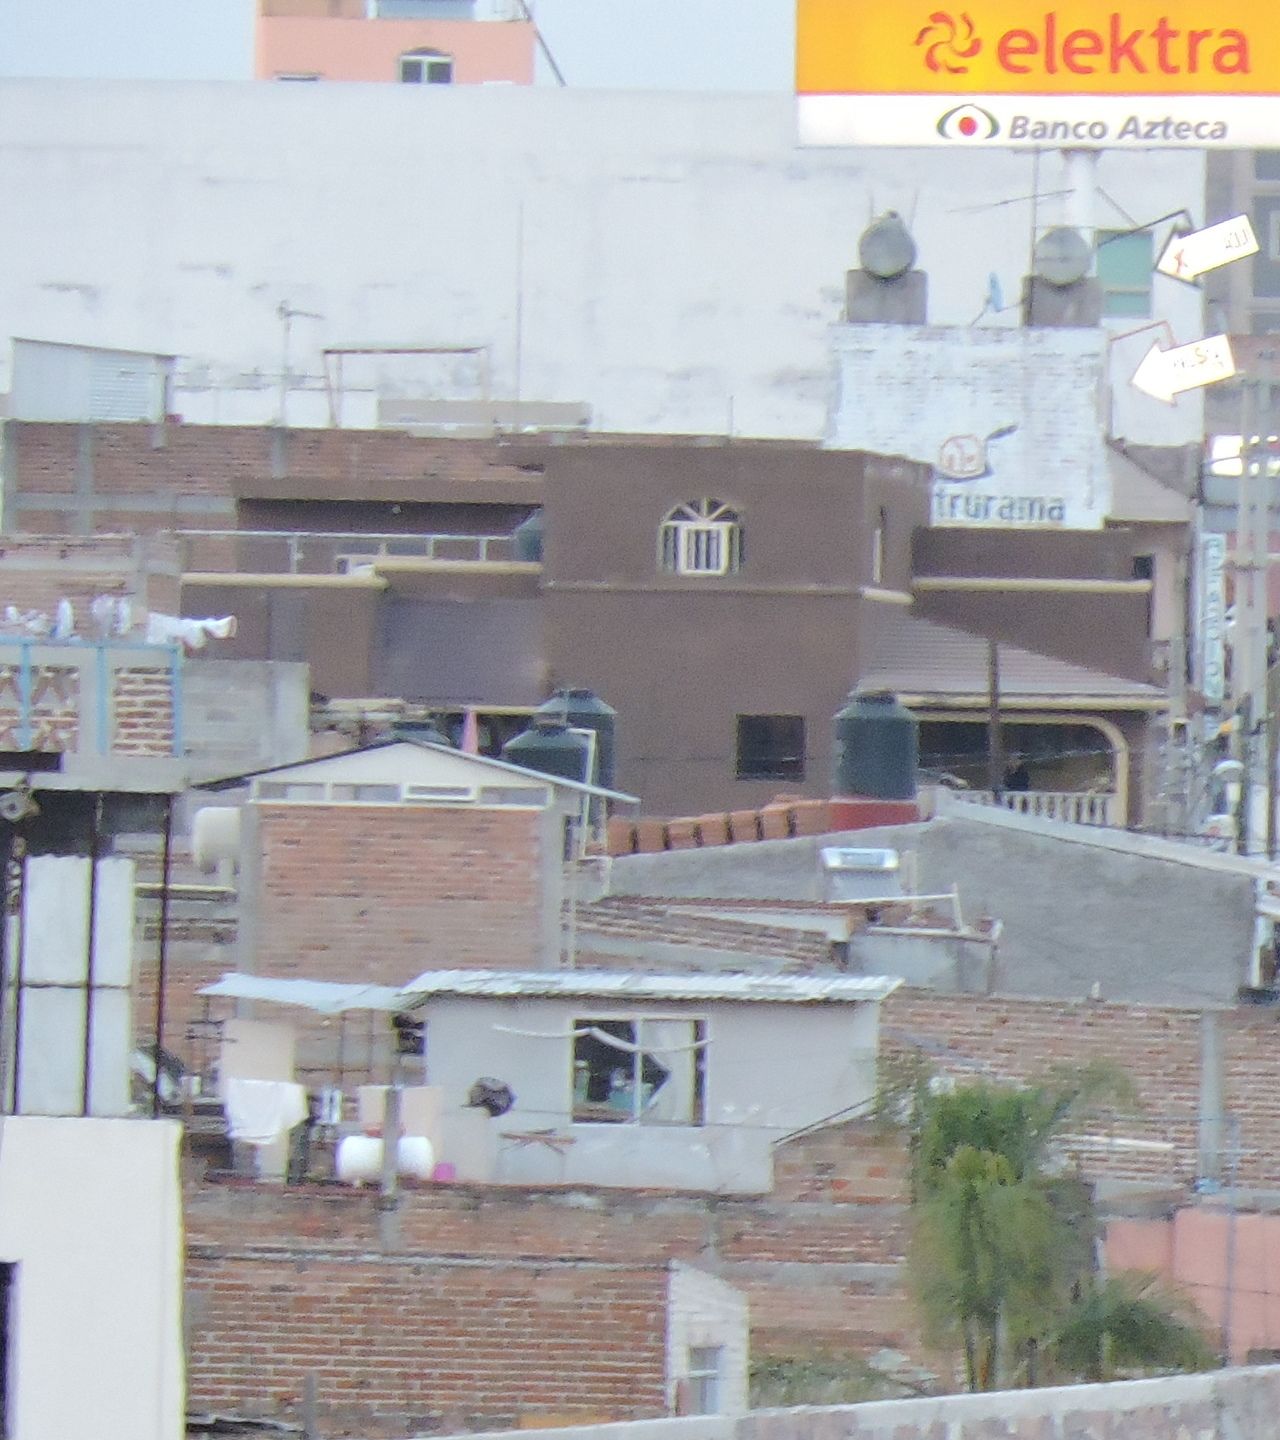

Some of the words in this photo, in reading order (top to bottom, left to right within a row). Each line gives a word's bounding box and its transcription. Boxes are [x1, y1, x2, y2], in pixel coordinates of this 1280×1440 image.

[997, 11, 1251, 75] elektra
[1008, 115, 1108, 141] Banco
[1117, 115, 1228, 141] Azteca
